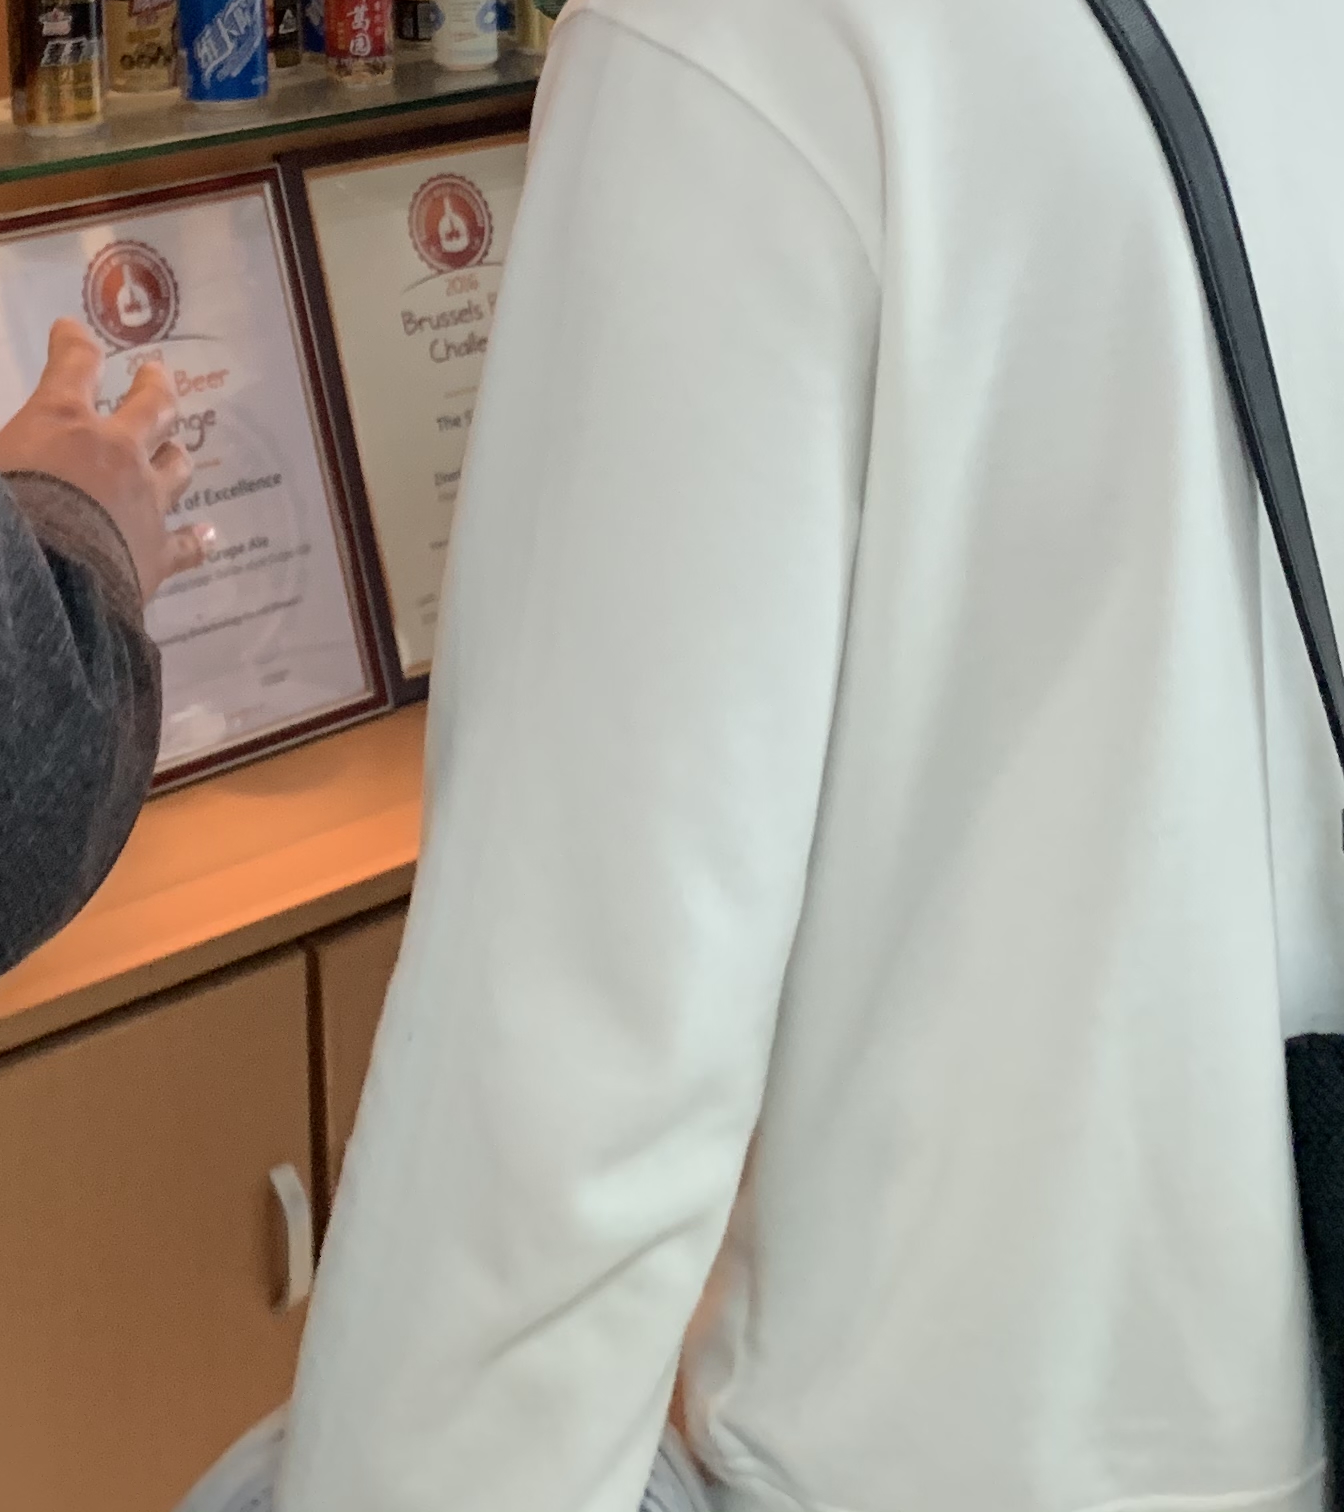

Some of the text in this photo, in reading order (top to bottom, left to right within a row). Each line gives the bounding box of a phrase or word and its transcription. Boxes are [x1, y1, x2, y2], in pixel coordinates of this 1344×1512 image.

[400, 299, 484, 337] Brussels
[174, 368, 230, 397] Beer
[204, 473, 283, 507] Excellence
